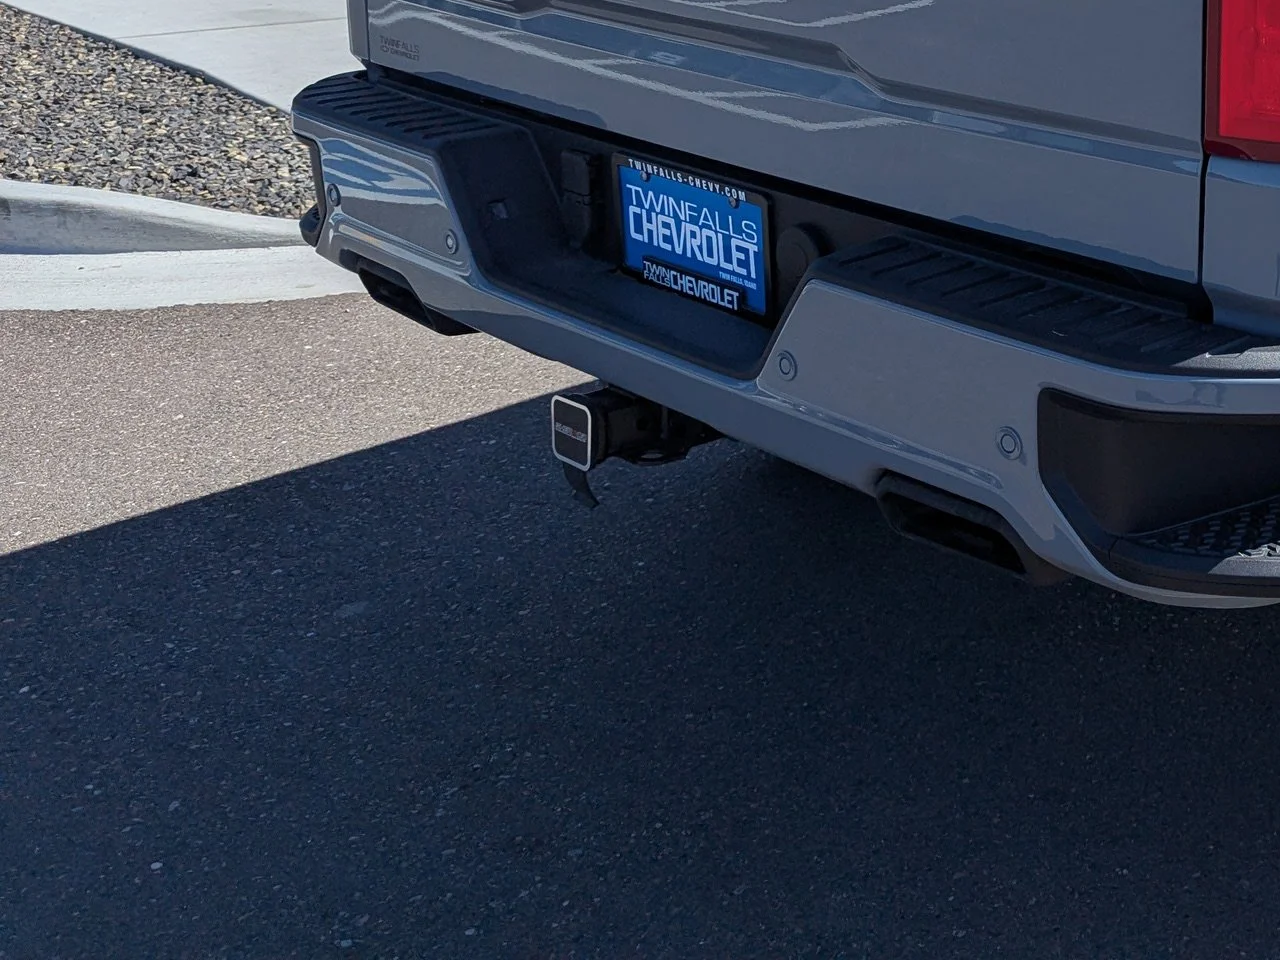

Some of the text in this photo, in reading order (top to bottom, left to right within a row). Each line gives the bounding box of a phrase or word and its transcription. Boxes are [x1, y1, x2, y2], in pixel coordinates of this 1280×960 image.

[628, 158, 747, 201] TWINFALLS-CHEVY.COM
[628, 205, 758, 279] CHEVROLET
[643, 260, 670, 279] TWIN
[643, 270, 671, 287] FALLS
[670, 270, 739, 310] CHEVROLET
